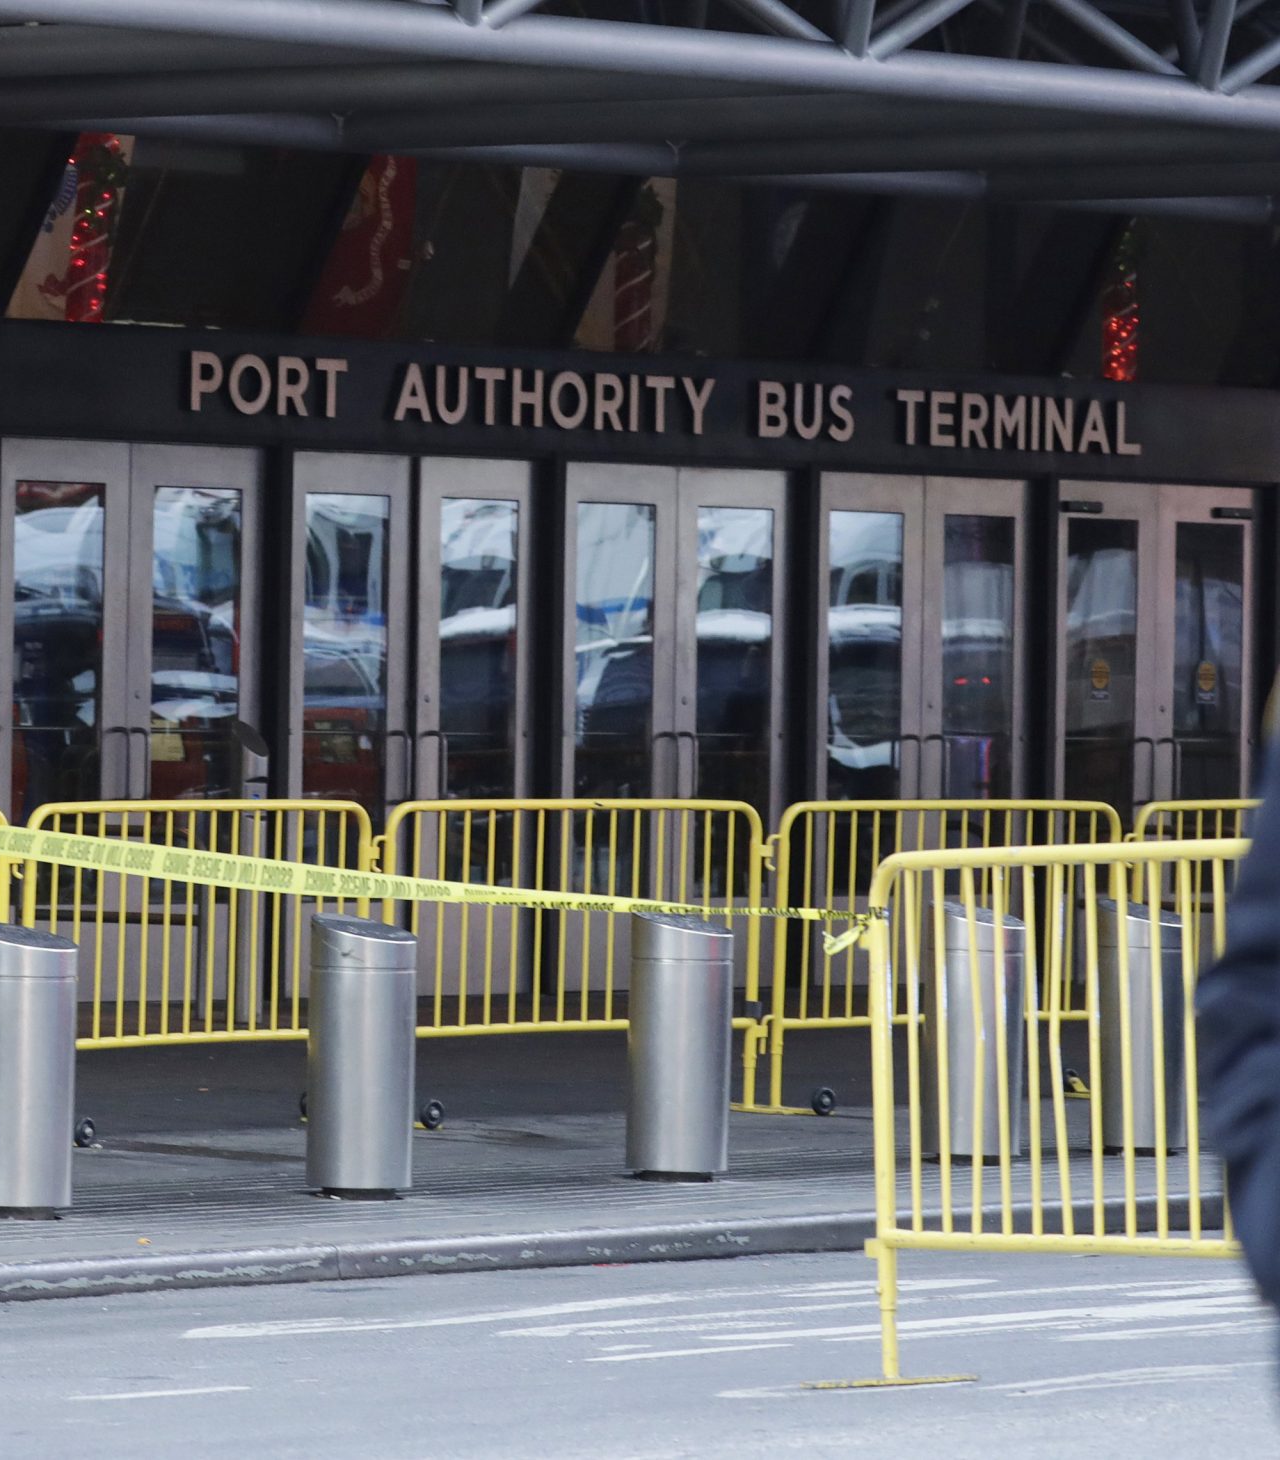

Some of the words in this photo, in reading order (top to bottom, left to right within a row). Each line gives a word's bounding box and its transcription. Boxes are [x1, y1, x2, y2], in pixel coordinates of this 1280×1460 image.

[191, 350, 348, 418] PORT
[394, 362, 715, 434] AUTHORITY
[758, 381, 854, 441] BUS
[897, 390, 1141, 455] TERMINAL
